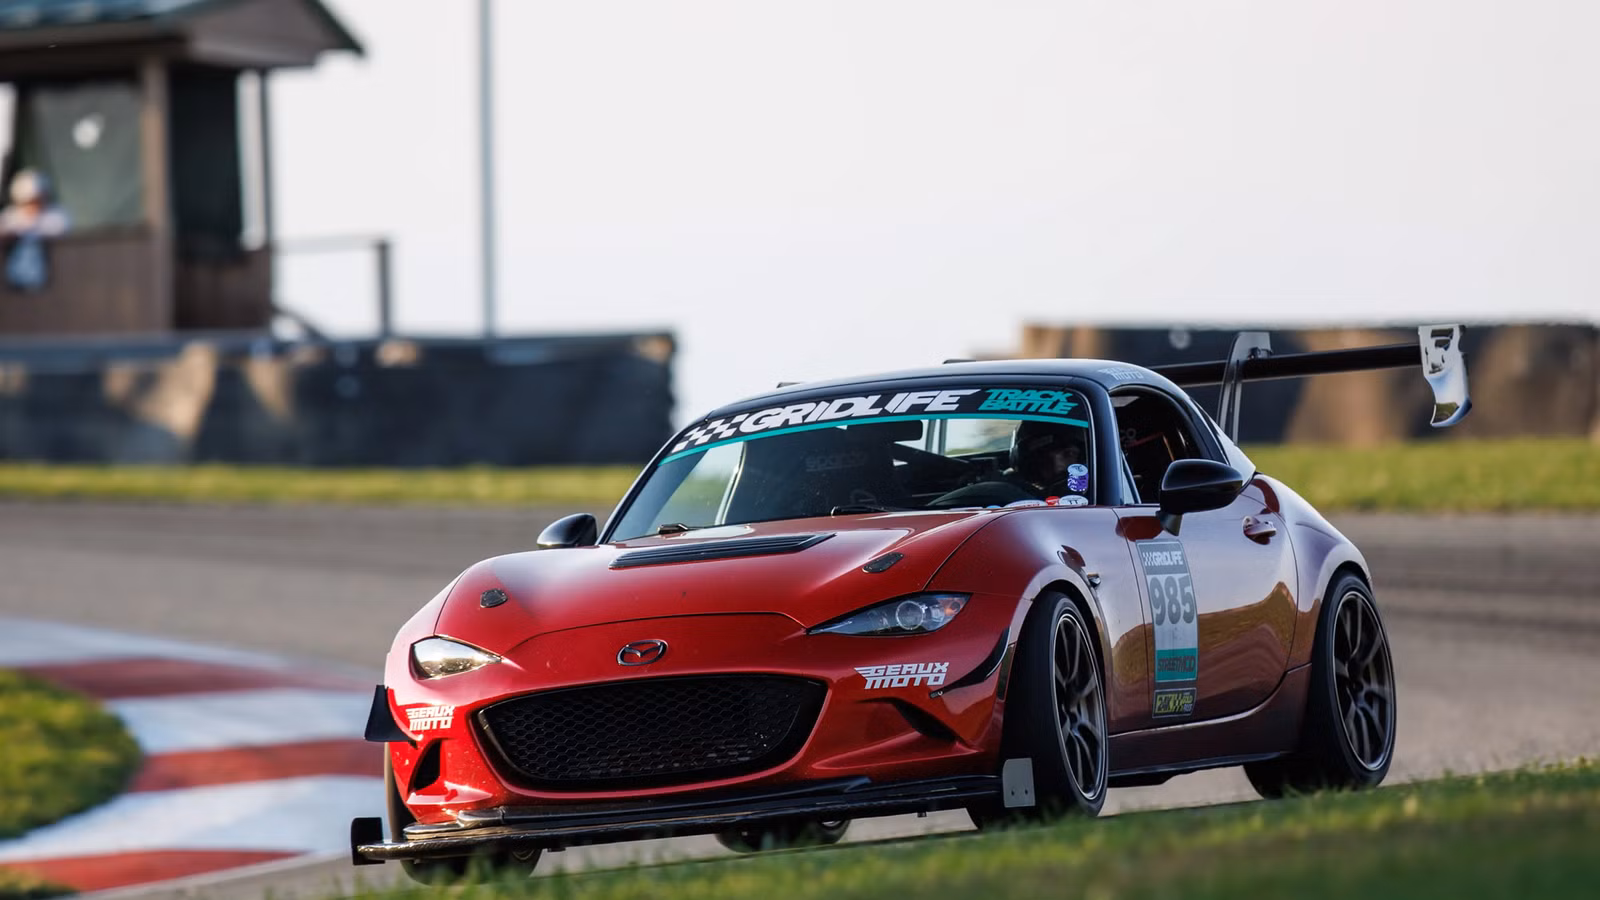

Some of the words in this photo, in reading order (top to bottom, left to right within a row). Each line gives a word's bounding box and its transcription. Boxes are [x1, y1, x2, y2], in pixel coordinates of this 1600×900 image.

[985, 388, 1073, 402] TRACK
[738, 389, 982, 434] GRIDLIFE
[978, 399, 1079, 415] BATTLE
[1152, 551, 1184, 566] GRIDLIFE
[1150, 575, 1195, 626] 985
[854, 662, 949, 679] GEAUX
[864, 673, 946, 690] MOTO
[405, 706, 456, 719] GEAUX
[409, 717, 453, 731] MOTO
